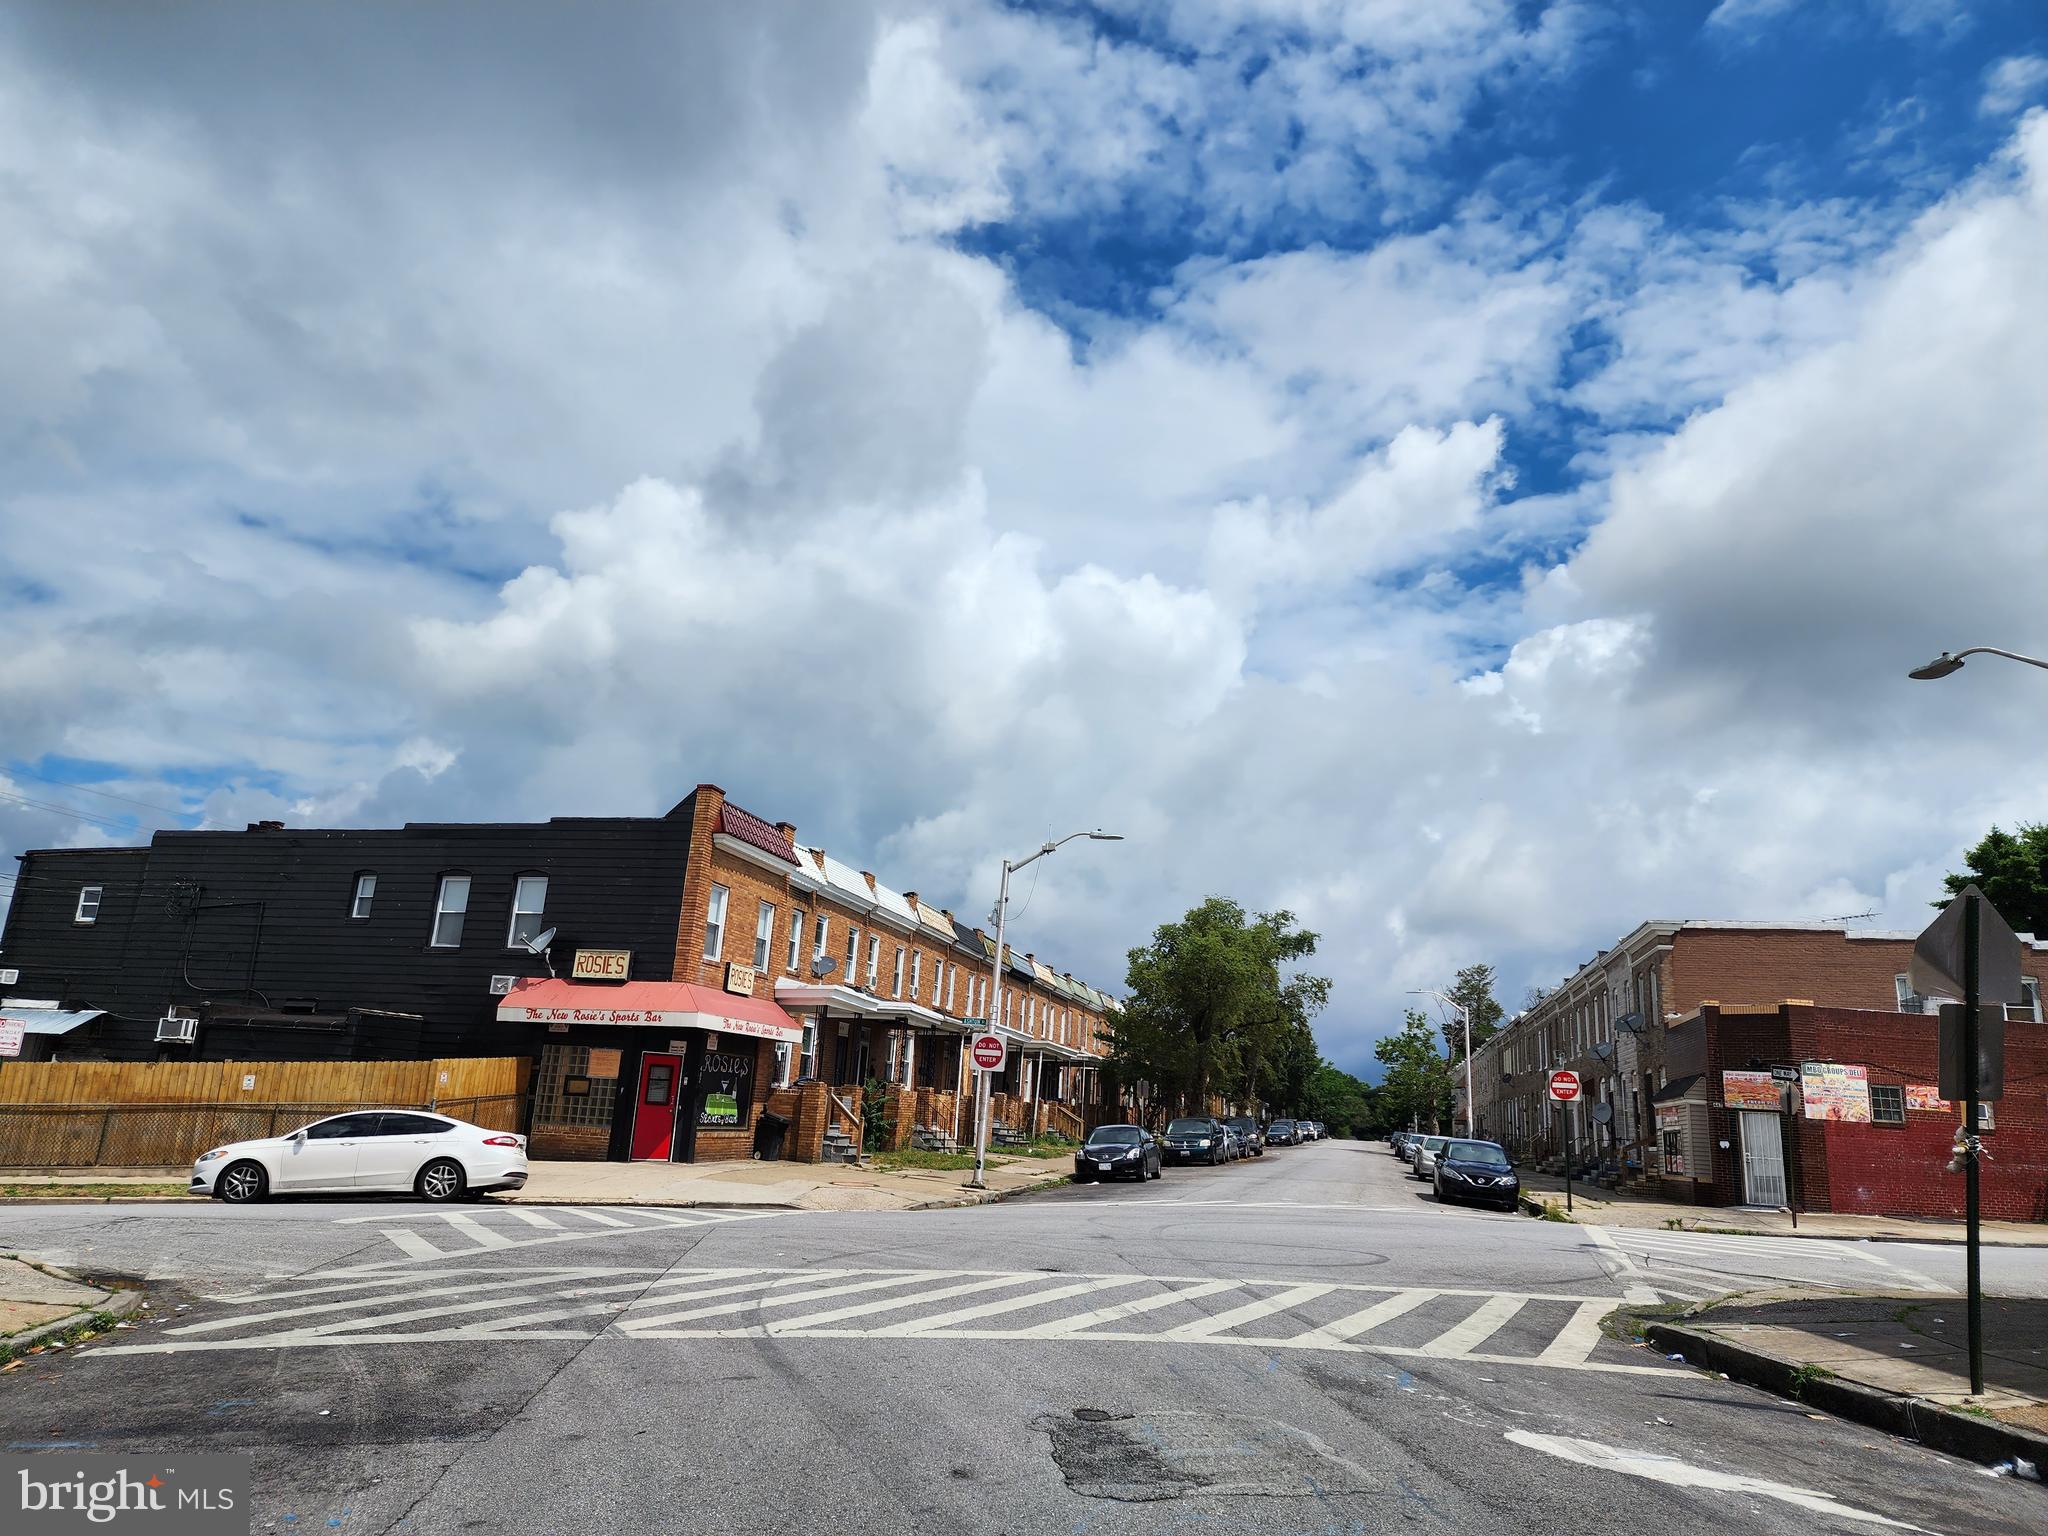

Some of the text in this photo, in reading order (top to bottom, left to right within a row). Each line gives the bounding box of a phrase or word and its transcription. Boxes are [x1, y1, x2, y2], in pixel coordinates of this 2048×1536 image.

[576, 954, 626, 975] ROSIE'S
[525, 1007, 663, 1024] The New Rosie's Sports Bar
[723, 1018, 732, 1029] The
[732, 1021, 744, 1031] New
[760, 1024, 775, 1036] Sports
[775, 1026, 784, 1037] Bar
[1822, 1066, 1849, 1076] GROUPS
[1849, 1069, 1863, 1077] DELI
